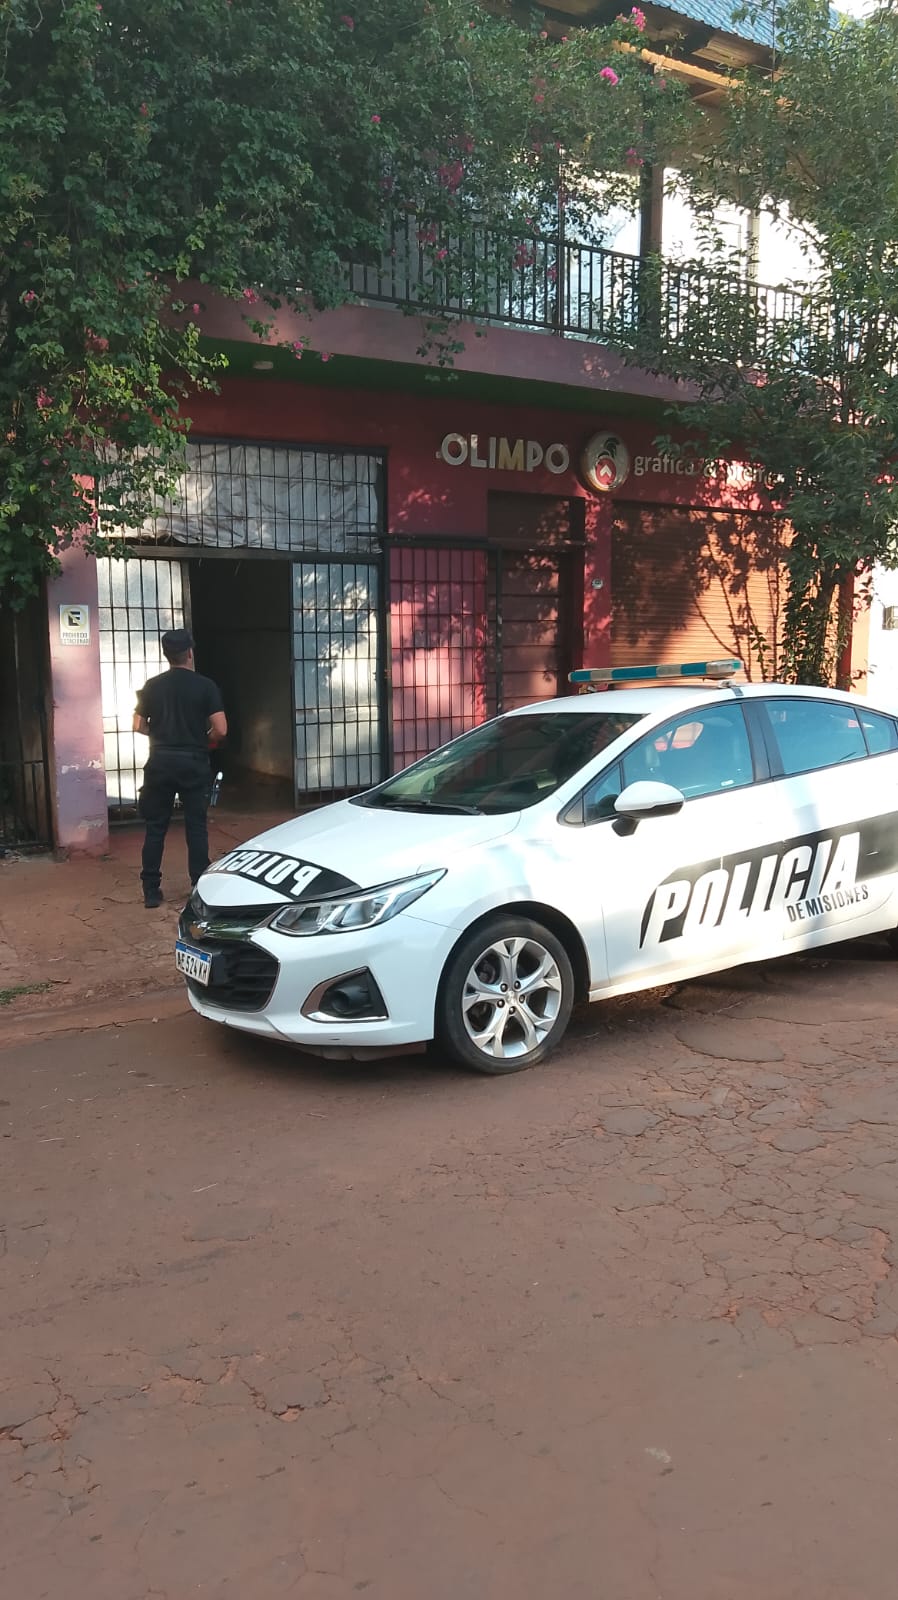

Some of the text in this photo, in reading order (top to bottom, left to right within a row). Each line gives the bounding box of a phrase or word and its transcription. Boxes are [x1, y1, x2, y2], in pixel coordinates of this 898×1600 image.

[441, 432, 569, 474] OLIMPO
[641, 831, 861, 947] POLICIA
[786, 884, 869, 923] DE MISIONES
[186, 955, 198, 976] 524
[198, 961, 208, 982] KH
